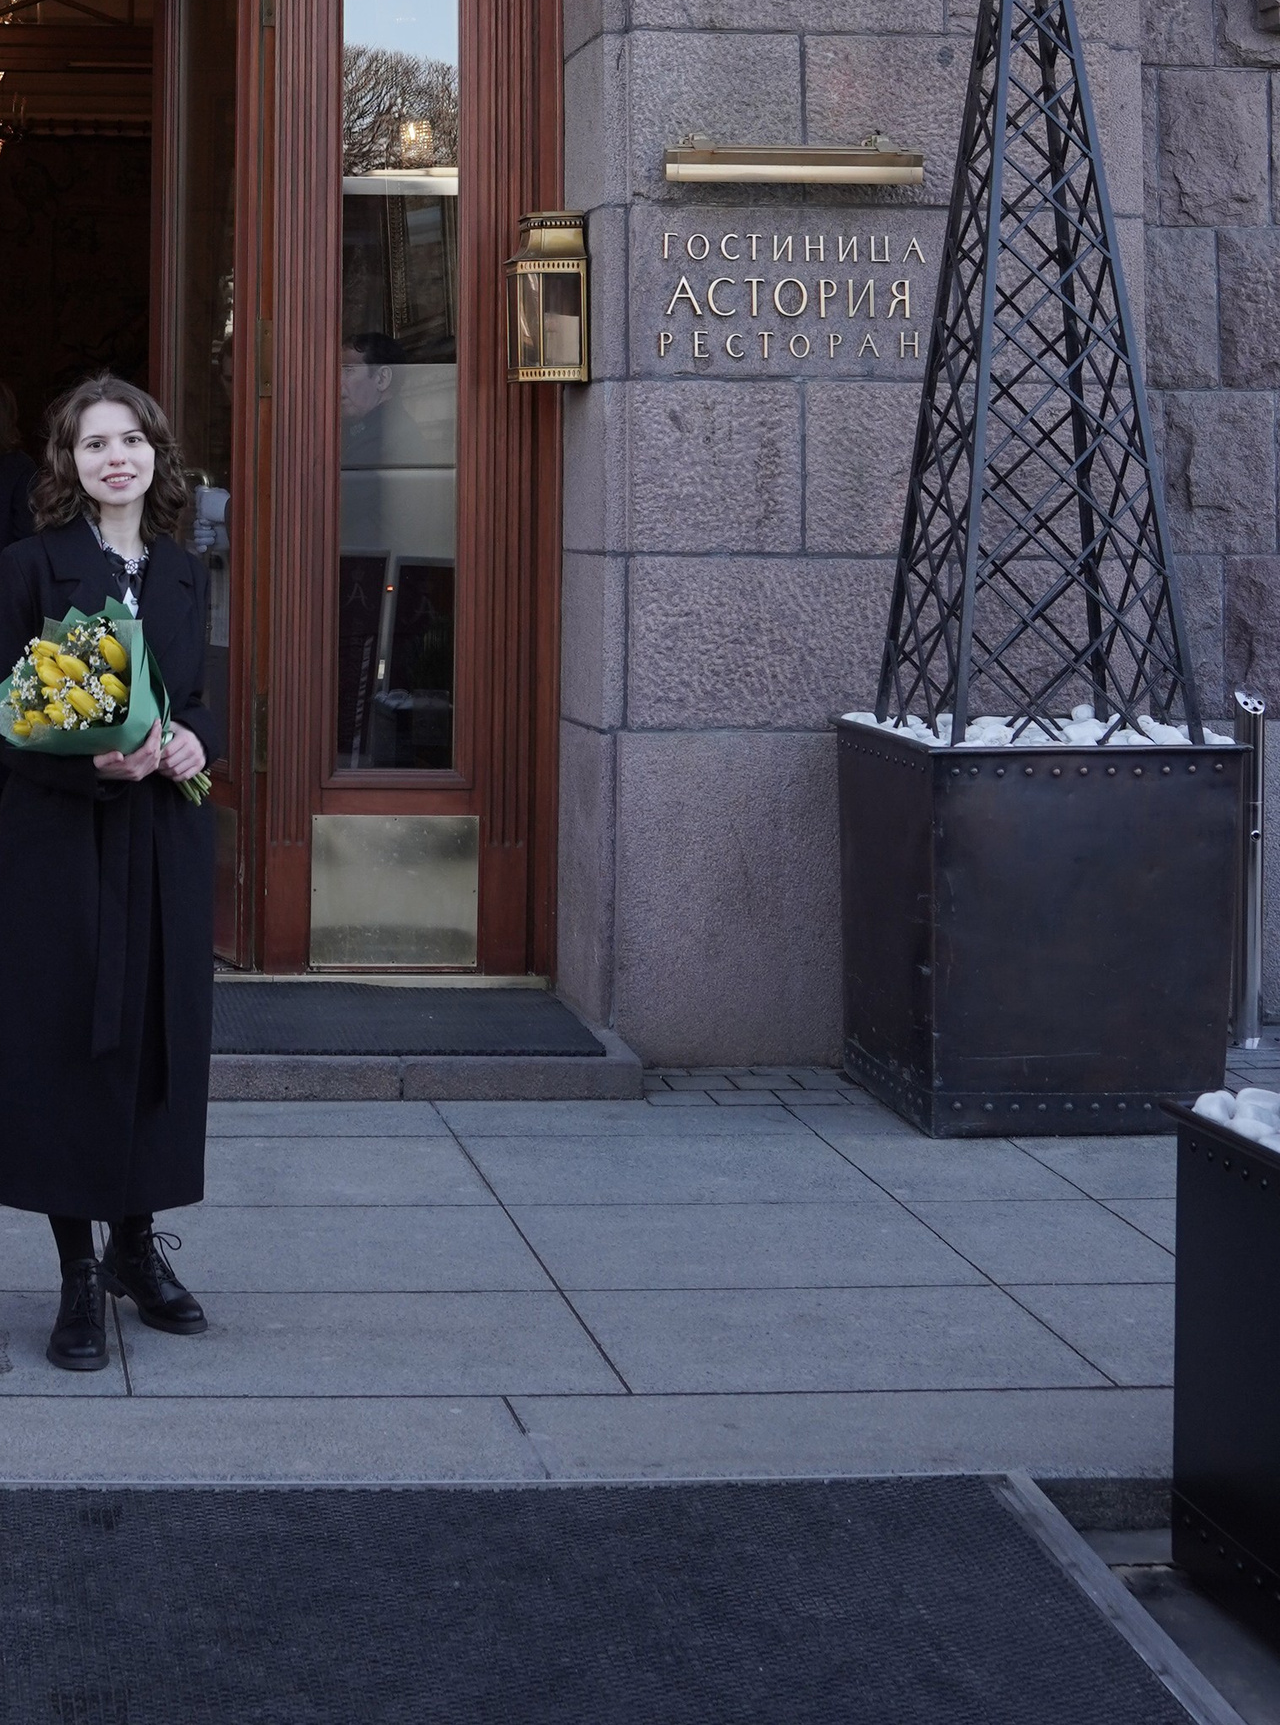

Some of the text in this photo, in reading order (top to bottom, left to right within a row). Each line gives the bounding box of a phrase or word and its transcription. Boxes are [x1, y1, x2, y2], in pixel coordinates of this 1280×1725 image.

[662, 232, 926, 264] ГОСТИНИЦА
[665, 276, 912, 319] АСТОРИЯ
[658, 330, 920, 359] РЕСТОРАН
